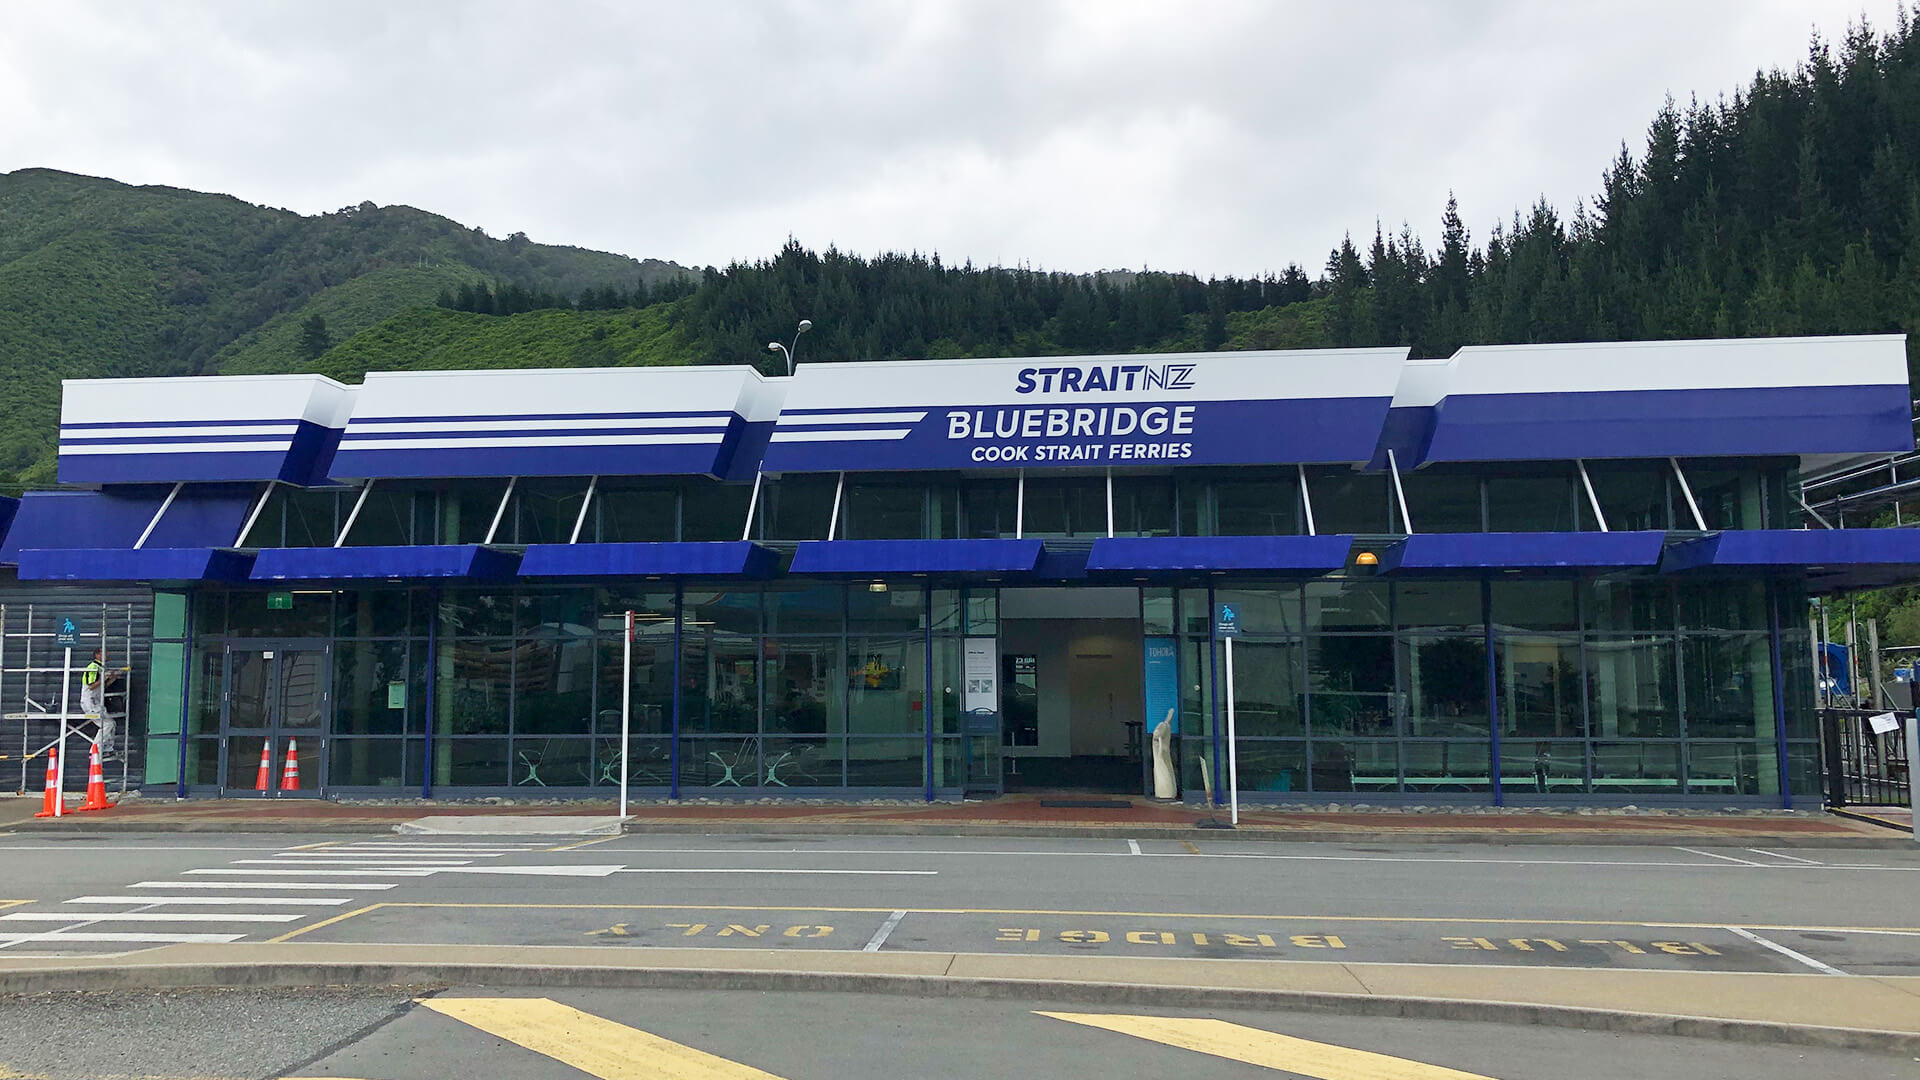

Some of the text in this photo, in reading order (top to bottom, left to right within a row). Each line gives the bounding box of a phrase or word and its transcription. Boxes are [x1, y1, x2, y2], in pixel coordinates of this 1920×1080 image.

[1015, 364, 1197, 394] STRAITNZ
[946, 405, 1196, 440] BLUEBRIDGE
[971, 442, 1193, 462] COOK STRAIT FERRIES
[583, 923, 1723, 956] BLUE BRIDGE ONLY
